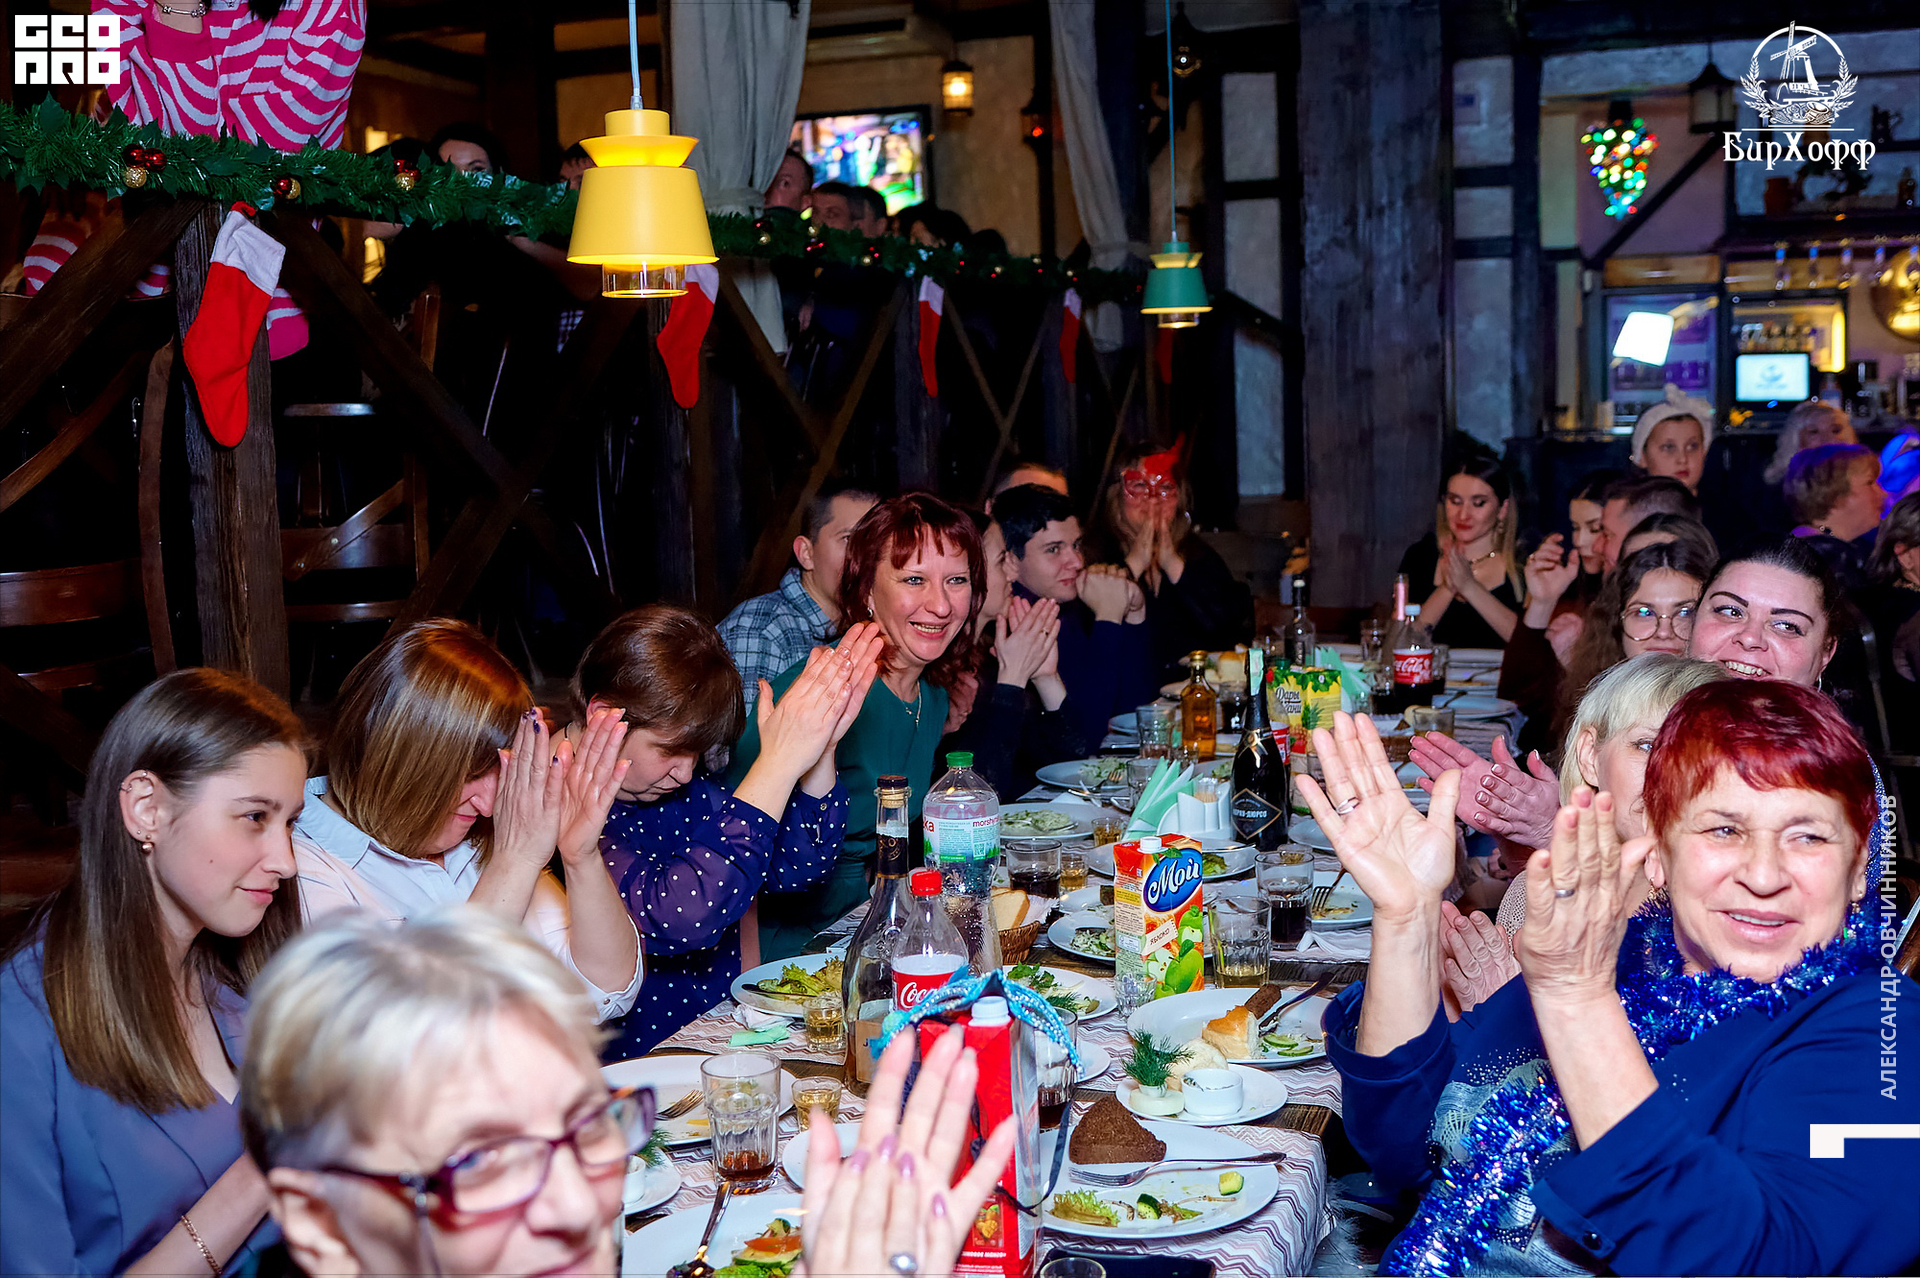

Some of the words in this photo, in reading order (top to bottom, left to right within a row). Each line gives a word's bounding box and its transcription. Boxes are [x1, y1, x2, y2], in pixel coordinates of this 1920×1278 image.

[1276, 687, 1300, 700] Дары
[1147, 858, 1200, 905] Мой
[1150, 927, 1170, 945] ЯБЛОКО
